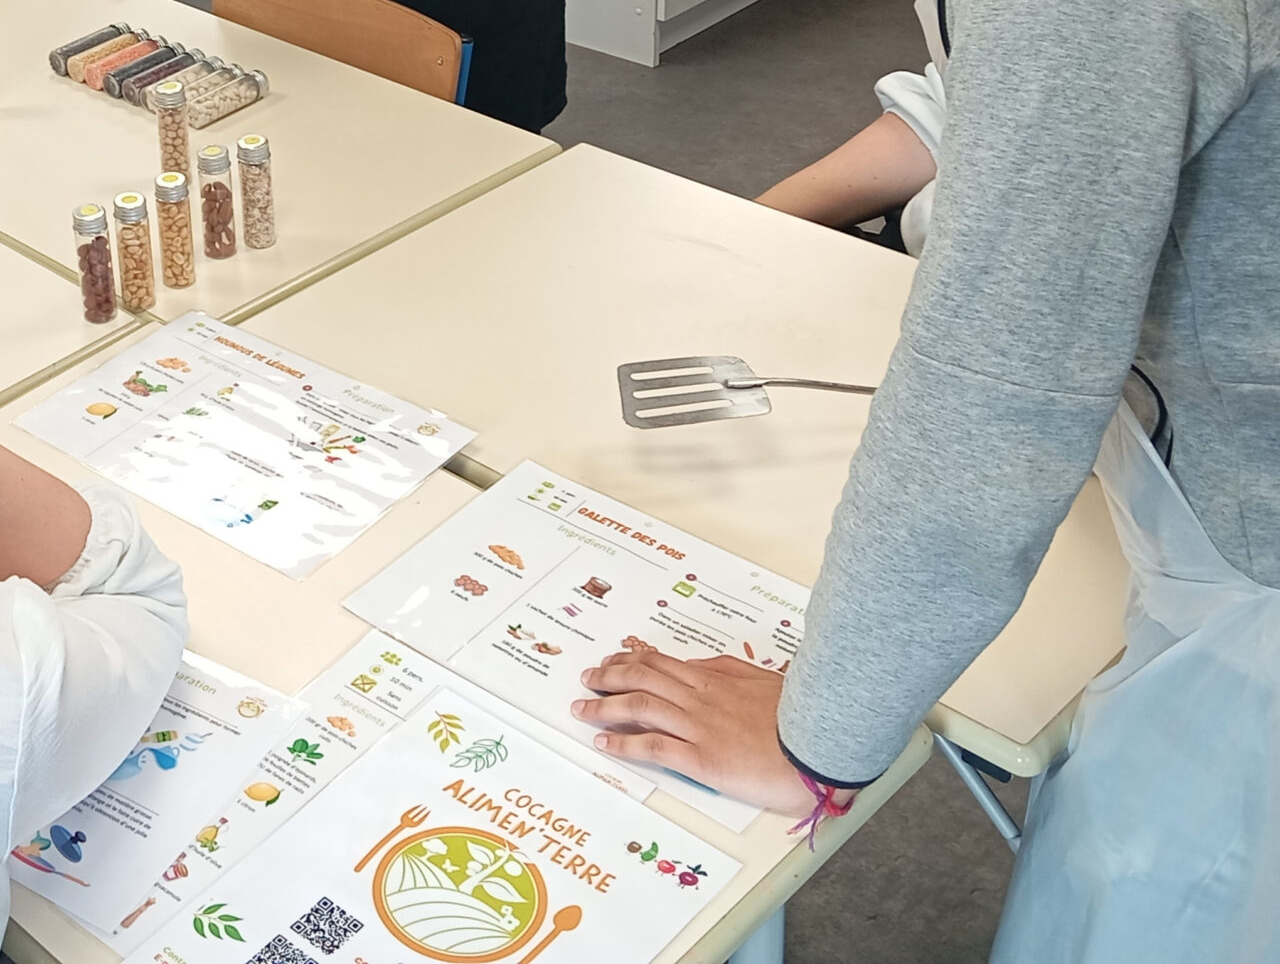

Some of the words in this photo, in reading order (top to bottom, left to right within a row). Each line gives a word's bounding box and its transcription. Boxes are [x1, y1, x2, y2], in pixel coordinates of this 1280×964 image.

[252, 353, 267, 361] DE
[265, 359, 306, 379] LÉGUMES
[557, 525, 616, 556] Ingrédients
[578, 507, 632, 534] GALETTE
[630, 532, 657, 546] DES
[656, 544, 686, 560] POIS
[751, 585, 805, 615] Préparat
[175, 671, 216, 694] aration
[390, 676, 400, 684] 10
[399, 682, 412, 691] min
[407, 671, 423, 682] pers.
[333, 693, 386, 727] Ingrédients
[376, 696, 398, 710] cuisson
[387, 691, 401, 702] Sans
[503, 788, 592, 847] COCAGNE
[442, 778, 617, 894] ALIMEN'TERRE
